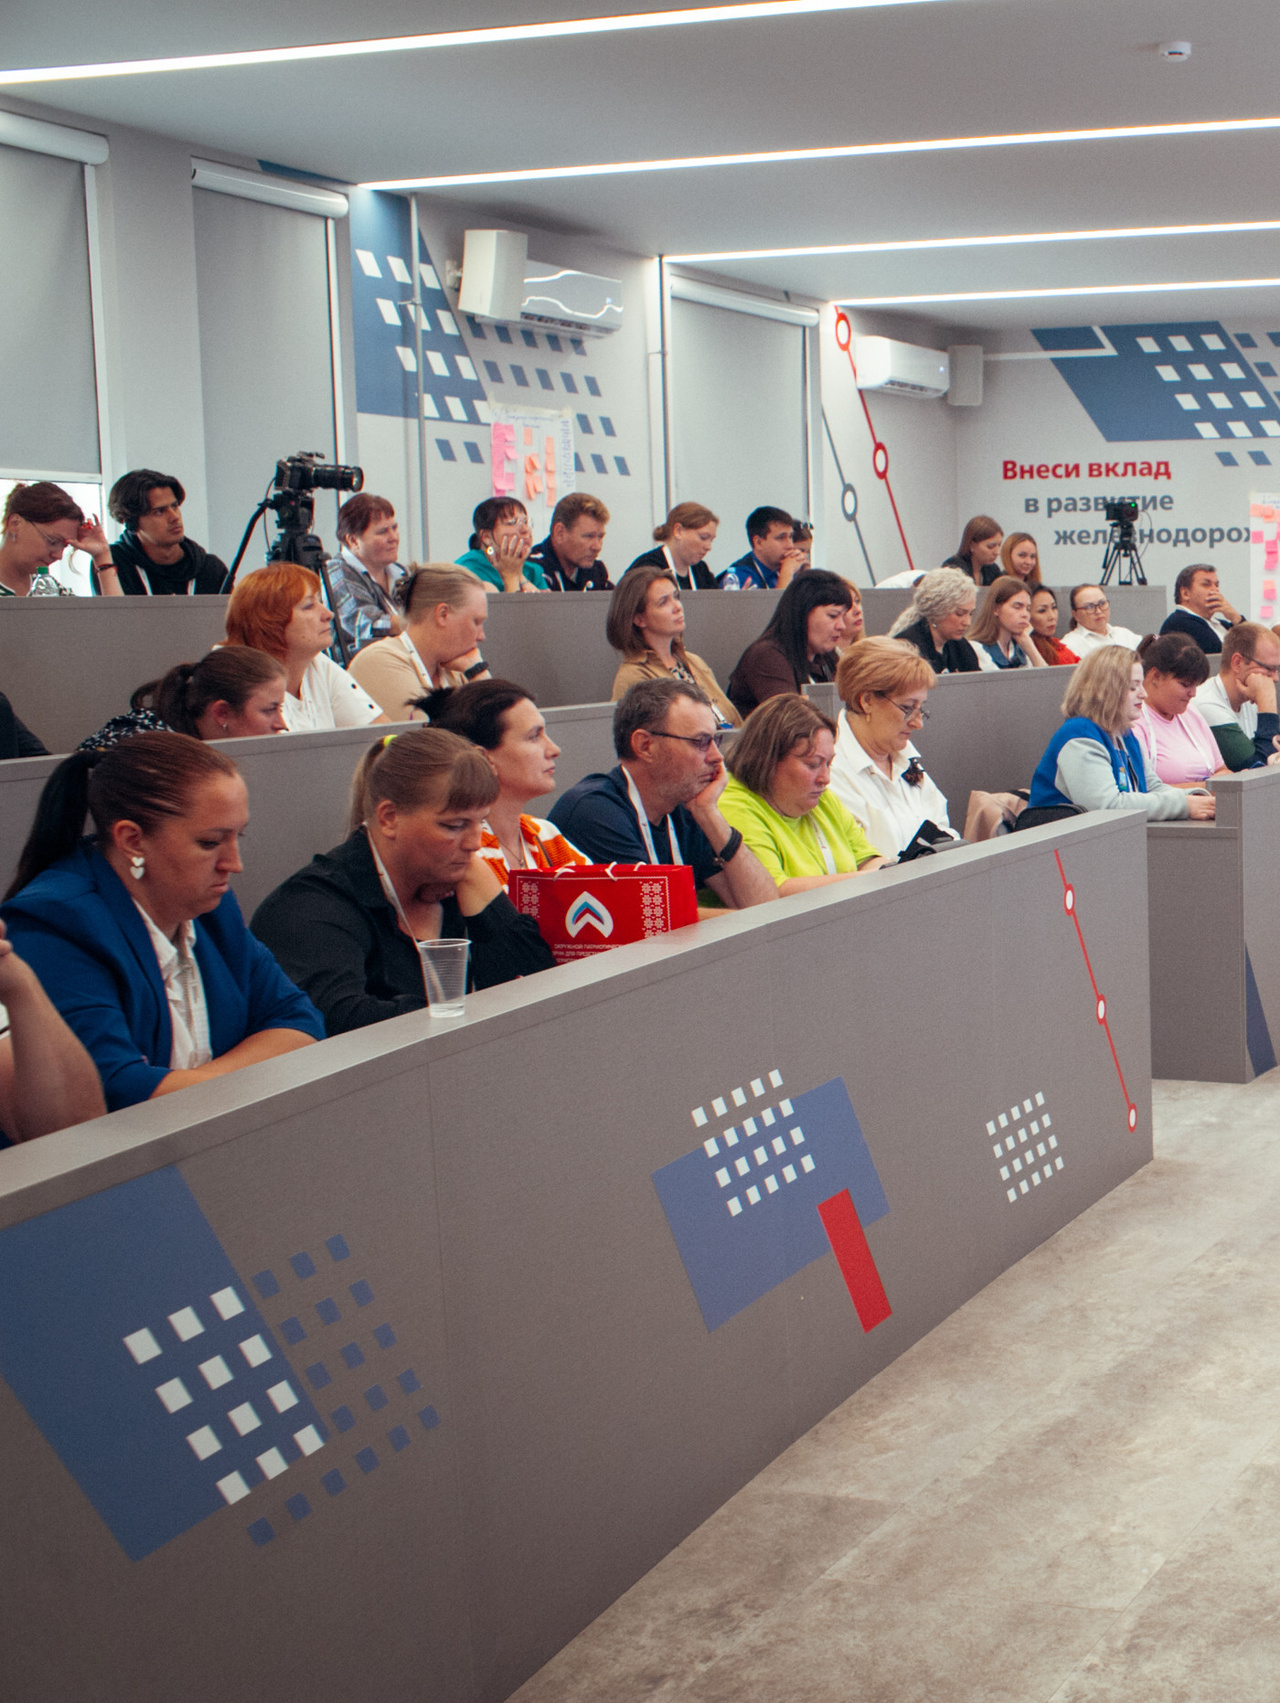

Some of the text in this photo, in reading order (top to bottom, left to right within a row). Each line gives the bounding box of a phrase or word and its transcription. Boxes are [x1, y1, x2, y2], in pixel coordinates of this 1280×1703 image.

[1002, 460, 1172, 480] Внеси вклад
[1024, 497, 1040, 513] в
